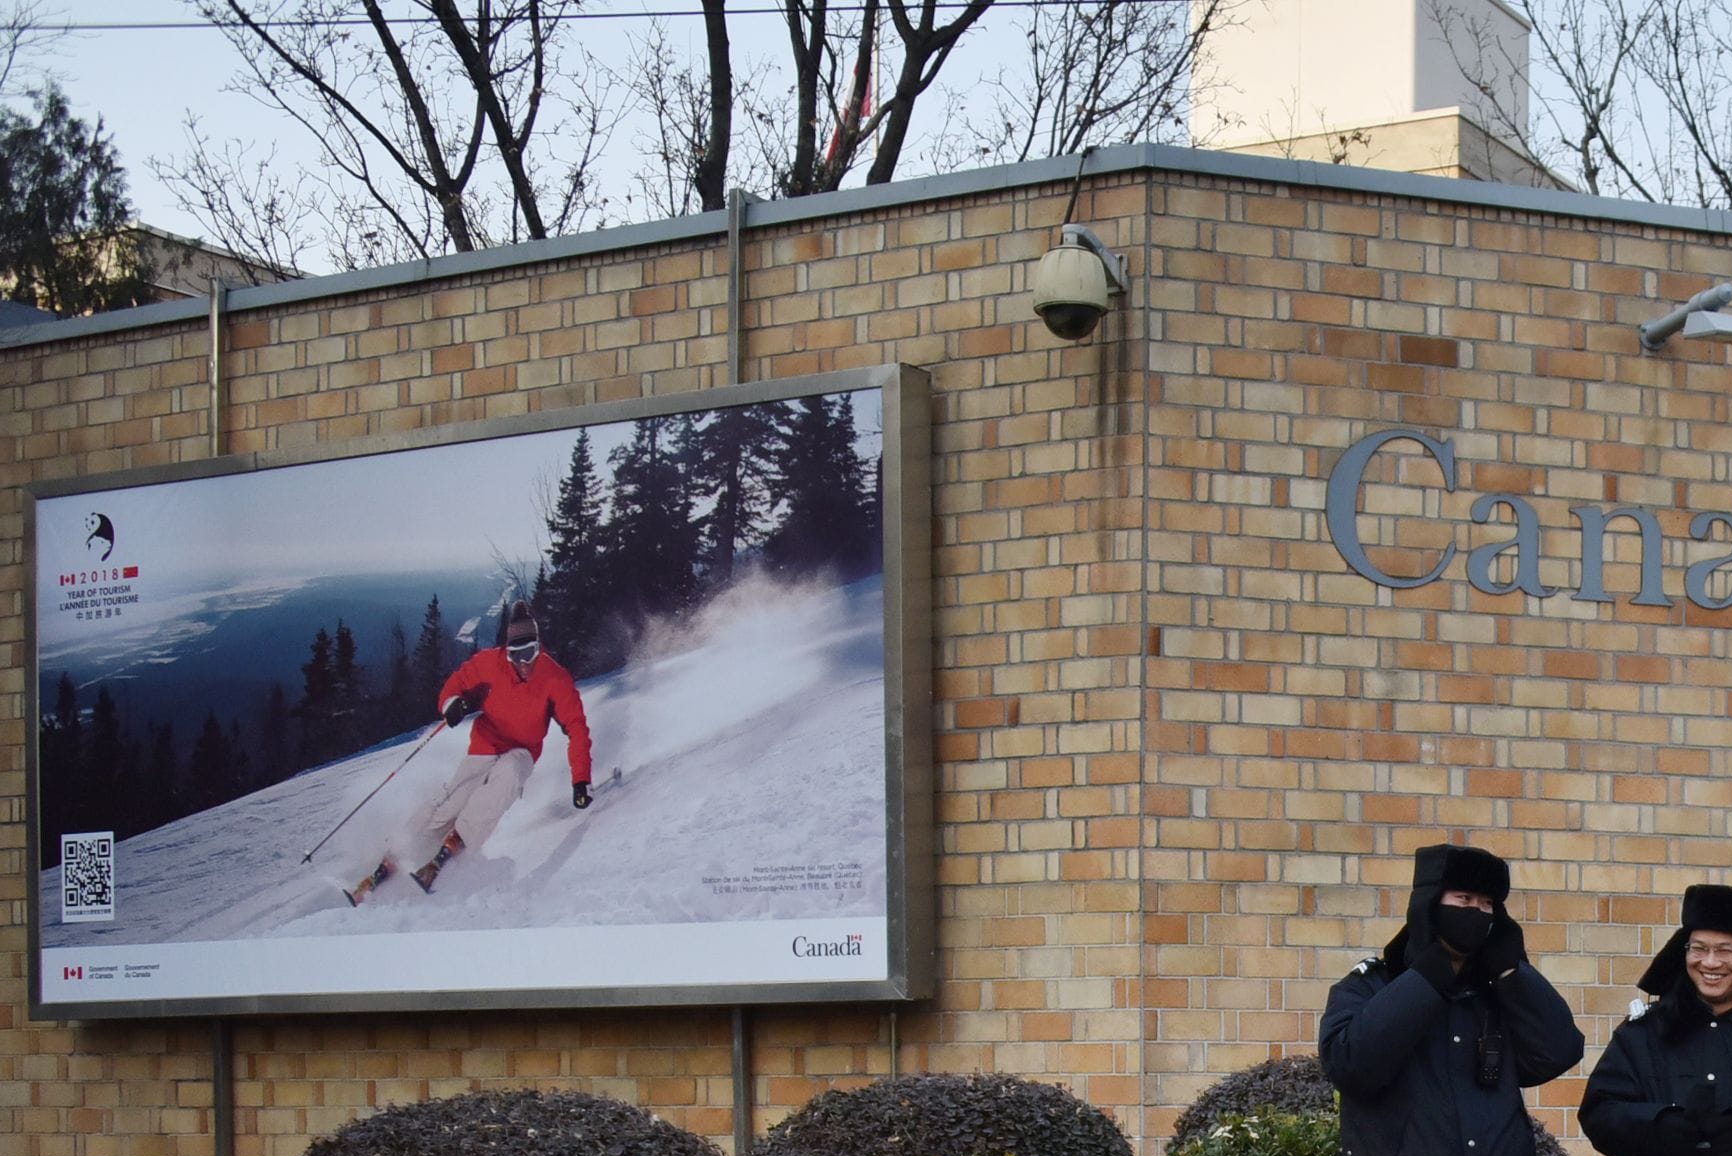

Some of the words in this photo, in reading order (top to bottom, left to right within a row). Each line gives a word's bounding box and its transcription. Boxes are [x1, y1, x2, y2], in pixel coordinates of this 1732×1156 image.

[80, 568, 119, 584] 2018
[67, 590, 85, 599] YEAR
[87, 588, 97, 597] OF
[99, 585, 131, 595] TOURISM
[90, 599, 101, 607] DU
[103, 594, 139, 606] TOURISME
[792, 934, 862, 958] Canada
